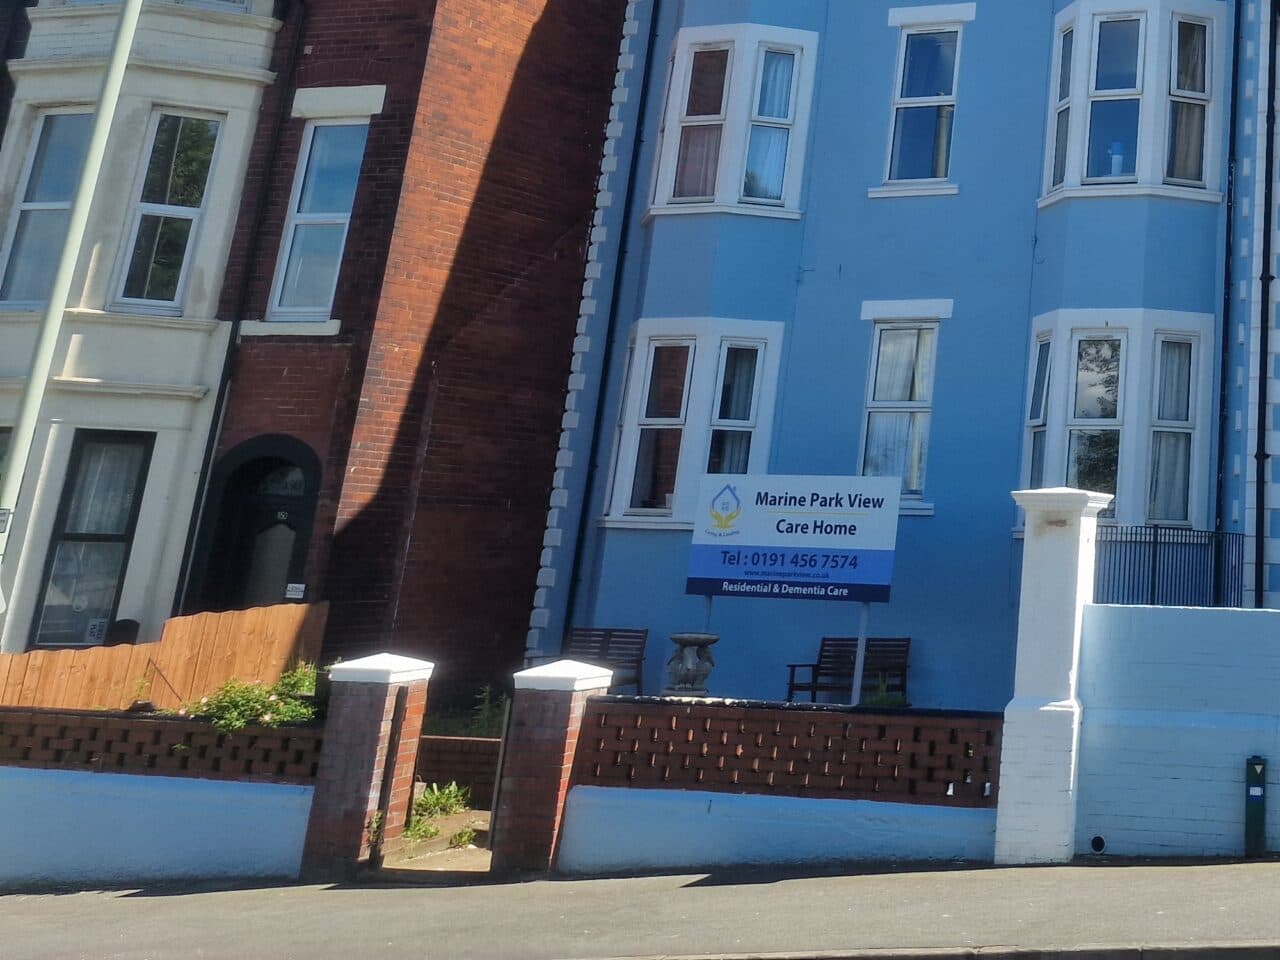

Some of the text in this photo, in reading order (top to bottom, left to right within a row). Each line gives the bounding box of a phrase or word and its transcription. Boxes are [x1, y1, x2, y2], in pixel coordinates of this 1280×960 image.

[755, 492, 885, 509] Marine Park View
[776, 519, 857, 536] Care Home
[751, 551, 785, 567] 0191
[790, 553, 817, 568] 456
[821, 554, 858, 570] 7574
[722, 581, 849, 596] Residential & Dementia Care
